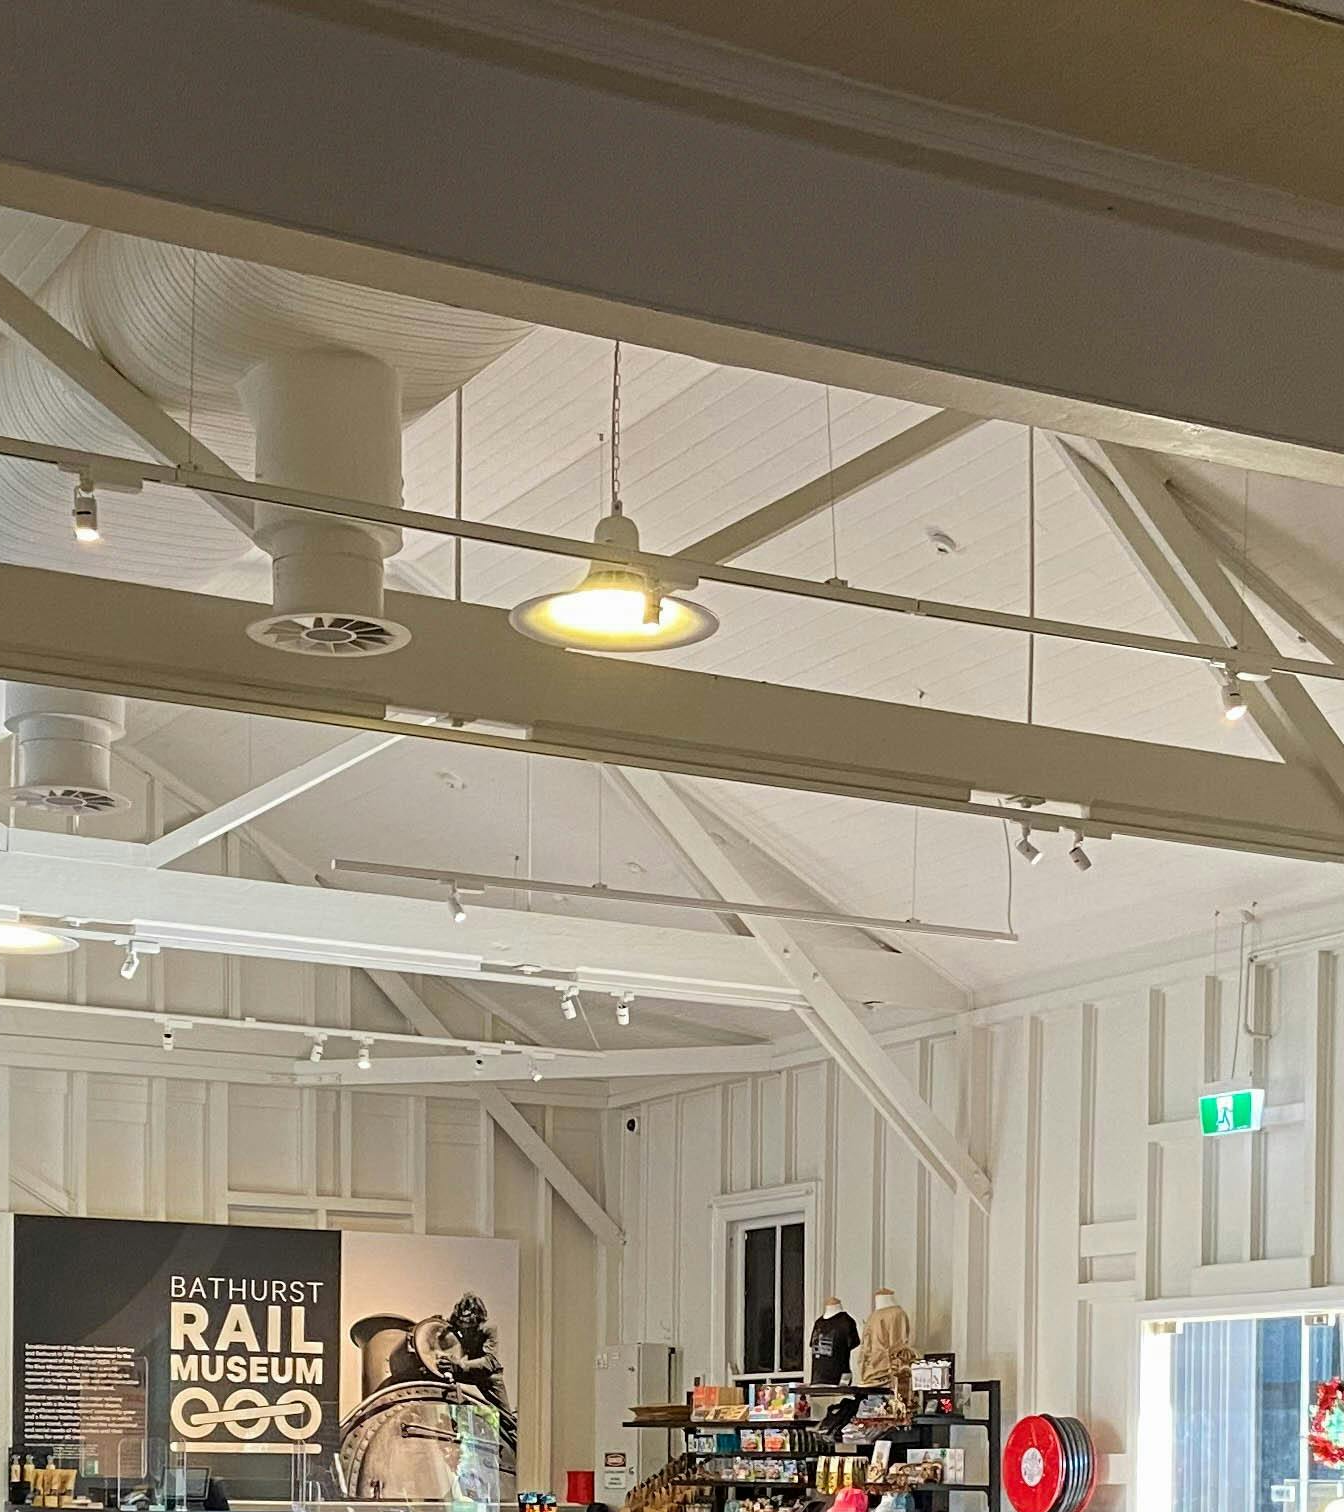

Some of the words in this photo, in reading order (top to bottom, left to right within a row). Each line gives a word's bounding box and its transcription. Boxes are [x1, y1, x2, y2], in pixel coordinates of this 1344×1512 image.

[171, 1276, 324, 1303] BATHURST
[171, 1302, 324, 1354] RAIL
[170, 1354, 323, 1385] MUSEUM
